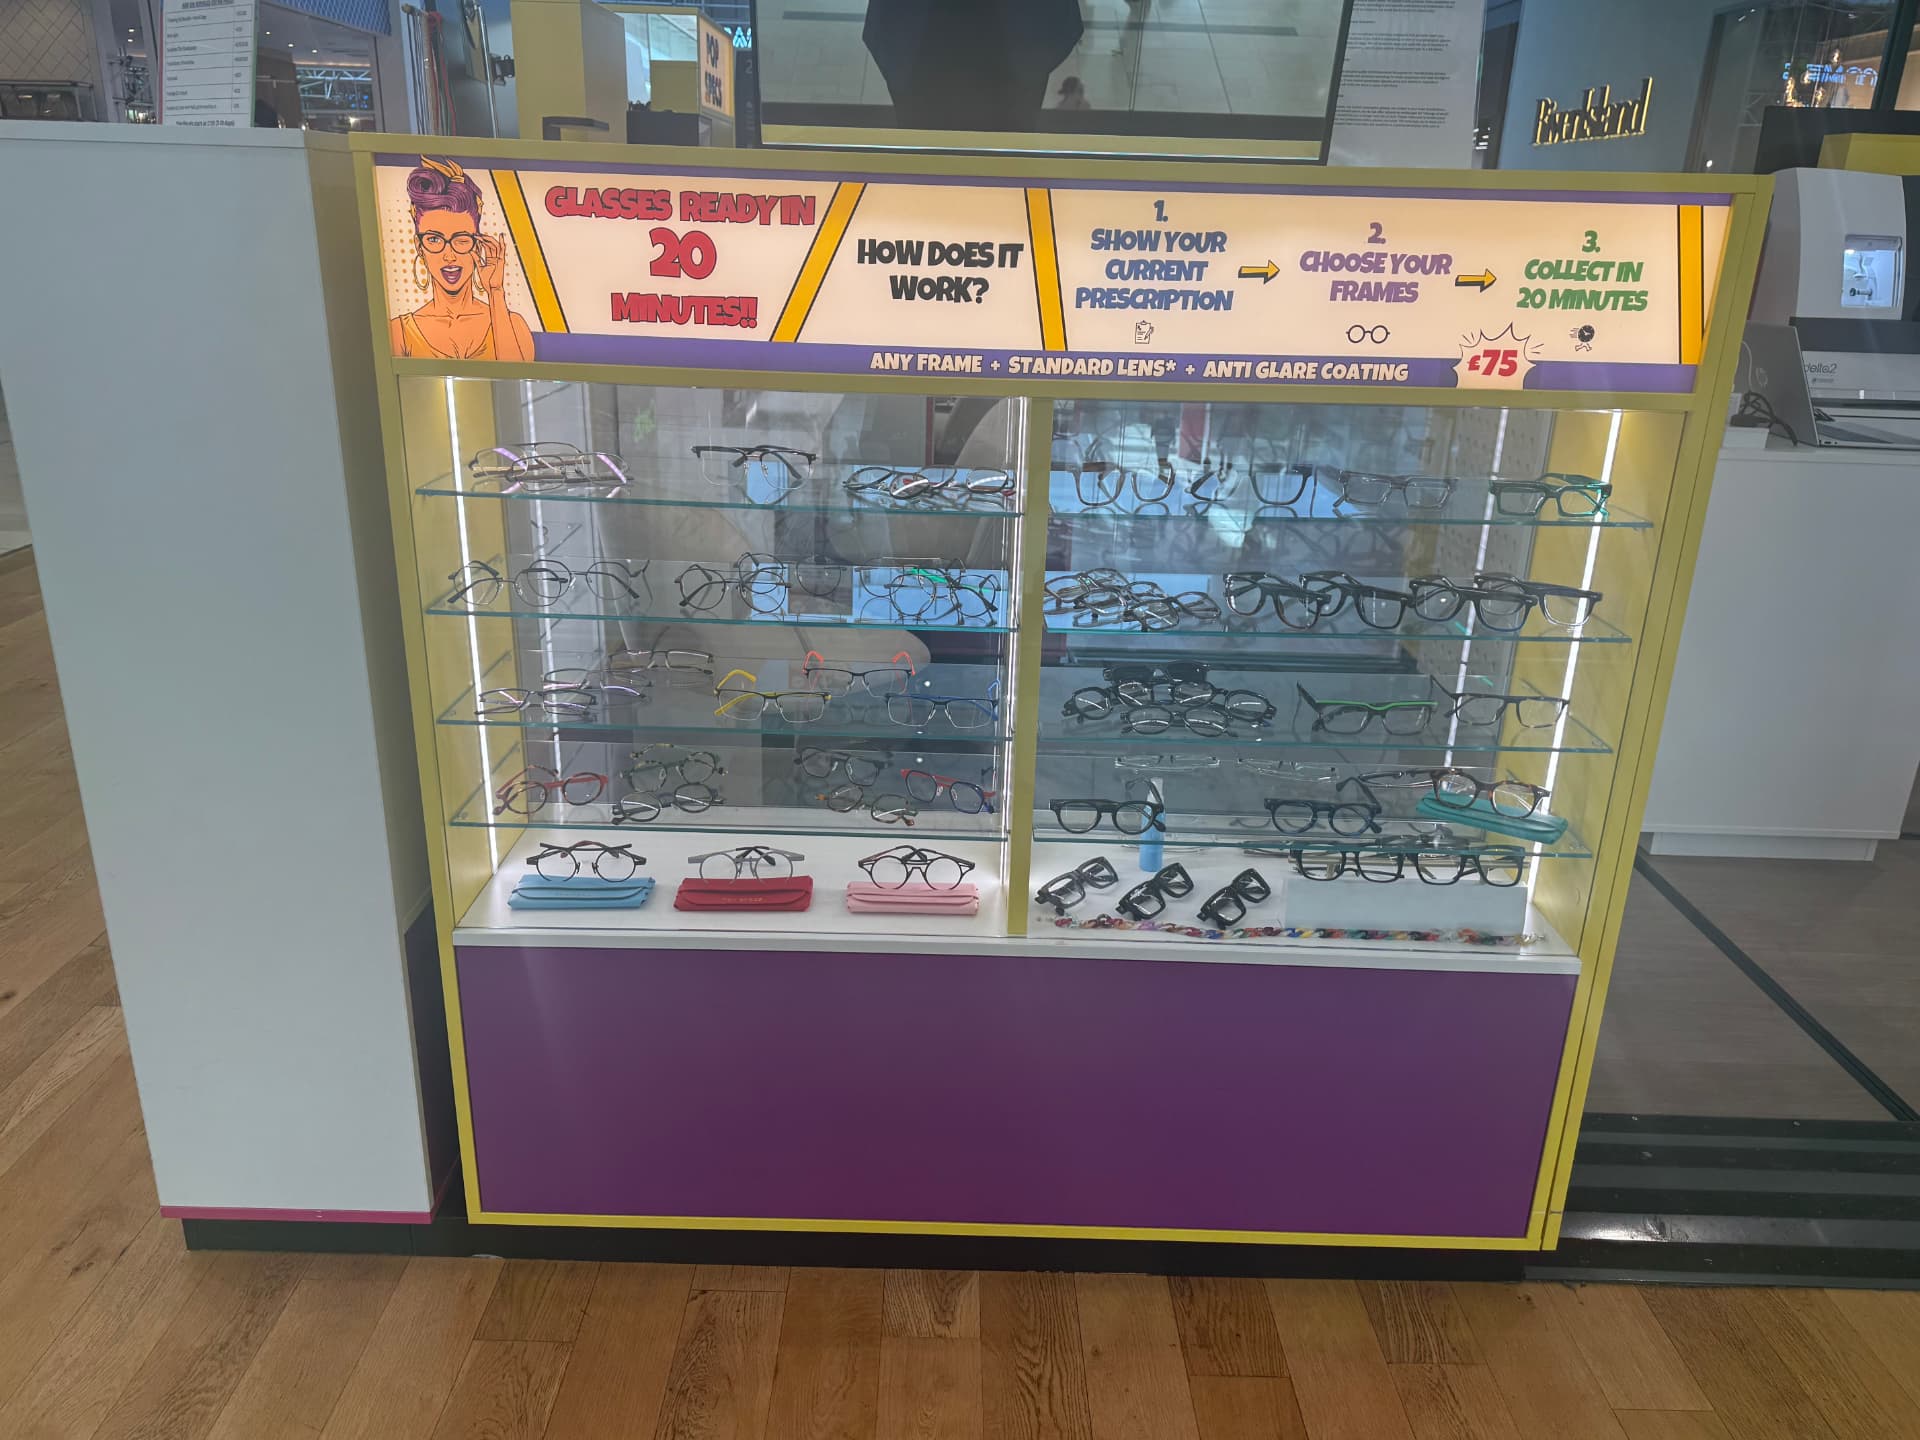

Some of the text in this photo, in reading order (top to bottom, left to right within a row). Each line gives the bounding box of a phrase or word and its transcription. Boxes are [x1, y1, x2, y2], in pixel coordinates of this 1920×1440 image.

[545, 186, 816, 226] GLASSES READY IN
[1153, 199, 1169, 222] 1.
[649, 227, 717, 279] 20
[1091, 228, 1227, 253] SHOW YOUR
[1582, 230, 1601, 253] 3.
[857, 239, 1025, 268] HOW DOES IT
[1299, 250, 1453, 276] CHOOSE YOUR
[1105, 258, 1209, 281] CURRENT
[1524, 259, 1644, 282] COLLECT IN
[889, 275, 990, 304] WORK?
[1075, 287, 1234, 311] PRESCRIPTION
[1329, 280, 1419, 303] FRAMES
[1516, 287, 1649, 311] 20 MINUTES
[611, 292, 758, 328] MINUTES!!
[870, 352, 914, 371] ANY
[916, 353, 983, 373] FRAME
[1008, 356, 1114, 376] STANDARD
[1203, 360, 1252, 379] ANTI
[1254, 361, 1319, 380] GLARE
[1320, 362, 1409, 381] COATING
[1467, 349, 1518, 377] £75
